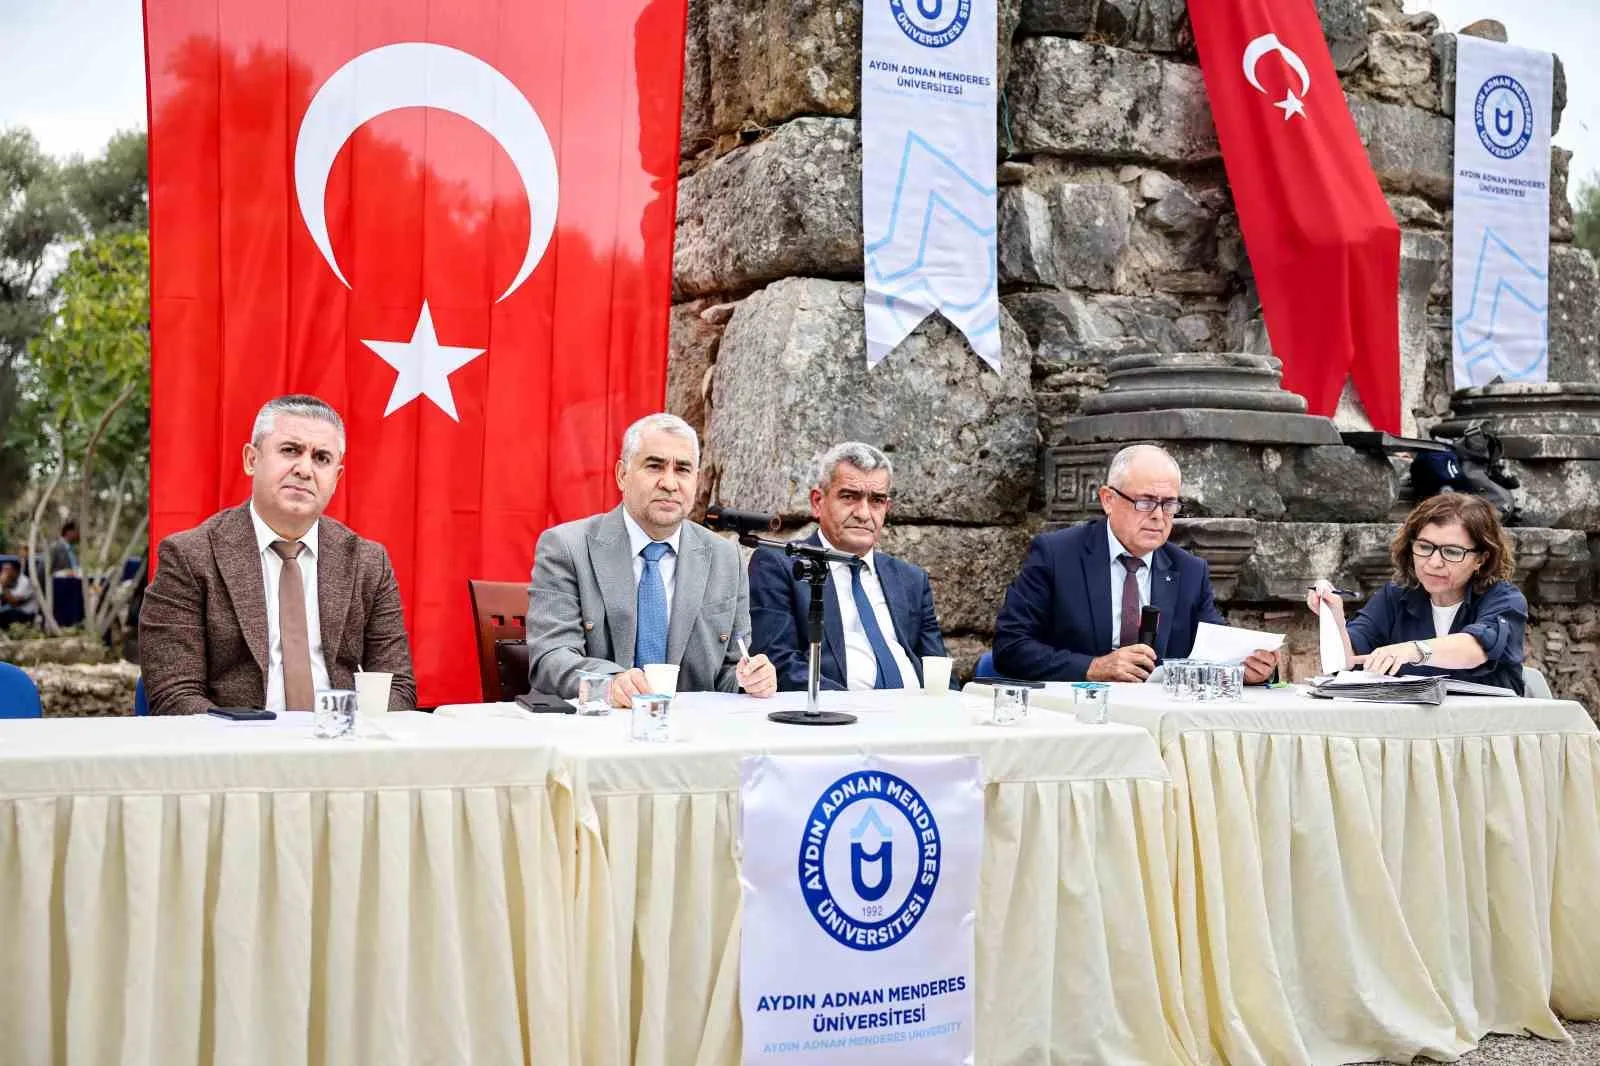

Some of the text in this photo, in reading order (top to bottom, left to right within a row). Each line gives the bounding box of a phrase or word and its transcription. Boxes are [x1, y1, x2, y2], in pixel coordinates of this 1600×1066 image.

[869, 60, 991, 87] AYDIN ADNAN MENDERES
[804, 776, 937, 891] AYDIN ADNAN MENDERES
[817, 893, 926, 946] ÜNİVERSİTESİ
[861, 905, 884, 918] 1992
[757, 975, 966, 1012] AYDIN ADNAN MENDERES
[813, 1003, 926, 1033] ÜNİVERSİTESİ
[763, 1041, 801, 1054] AYDIN
[801, 1038, 847, 1051] ADNAN
[849, 1031, 907, 1047] MENDERES
